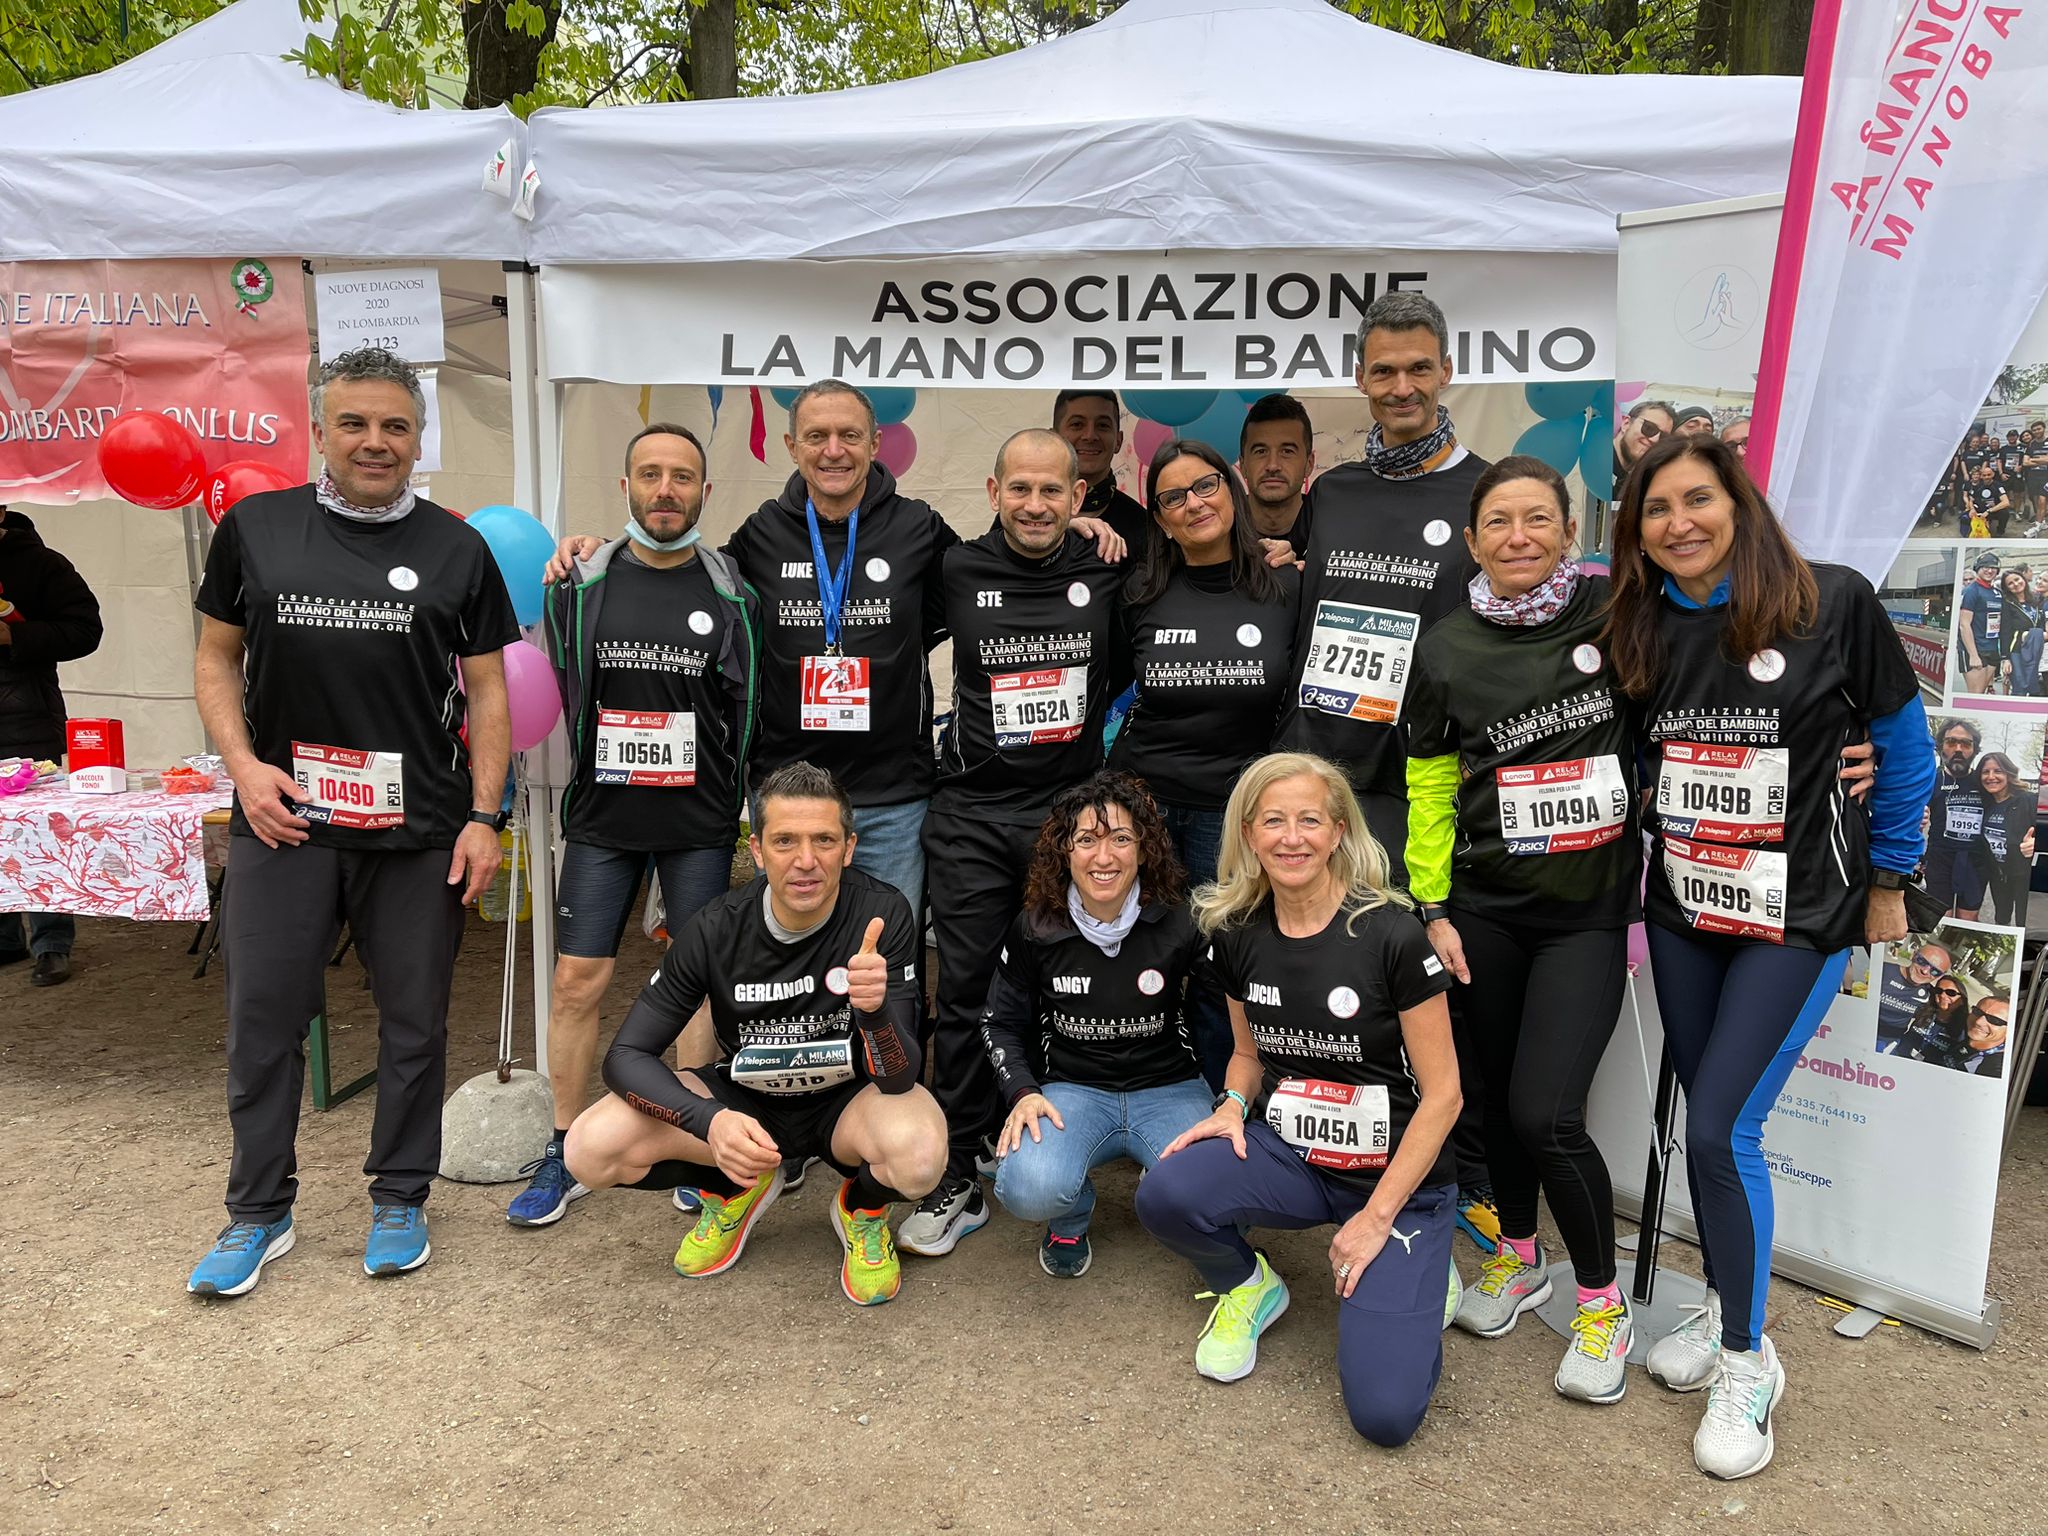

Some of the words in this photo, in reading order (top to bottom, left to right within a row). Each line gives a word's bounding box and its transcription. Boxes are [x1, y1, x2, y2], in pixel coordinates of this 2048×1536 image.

[328, 282, 367, 295] NUOVE
[370, 279, 425, 292] DIAGNOSI
[43, 291, 212, 328] ITALIANA
[365, 298, 390, 310] 2020
[338, 320, 350, 330] IN
[352, 315, 421, 329] LOMBARDIA
[720, 333, 806, 378] LA
[832, 335, 1045, 381] MANO
[1072, 335, 1207, 381] DEL
[1234, 326, 1597, 380] BAINO
[1327, 558, 1339, 567] LA
[1340, 559, 1369, 570] MANO
[1370, 562, 1389, 573] DEL
[1390, 565, 1437, 579] BAMBINO
[1330, 550, 1440, 569] ASSOCIAZIONE
[781, 562, 813, 579] LUKE
[1325, 569, 1434, 590] MANOBAMBINO.ORG
[277, 593, 415, 612] ASSOCIAZIONE
[779, 598, 891, 606] ASSOCZIONE
[977, 590, 1003, 608] STE
[277, 603, 292, 613] LA
[294, 604, 331, 617] MANO
[334, 607, 356, 618] DEL
[359, 609, 413, 623] BAMBINO
[779, 608, 789, 616] LA
[792, 608, 821, 617] MANO
[779, 616, 891, 627] MANOBAINO.ORG
[1325, 612, 1355, 624] Telepass
[1379, 619, 1413, 631] MILANO
[277, 615, 411, 634] MANOBAMBINO.ORG
[979, 632, 1092, 646] ASSOCIAZIONE
[1154, 629, 1197, 645] BETTA
[1347, 635, 1370, 645] FABRIZIO
[595, 641, 710, 659] ASSOCIAZIONE
[980, 647, 993, 656] LA
[995, 644, 1025, 655] MANO
[1027, 643, 1046, 652] DEL
[1048, 640, 1092, 652] BAMBINO
[597, 651, 607, 659] LA
[608, 650, 638, 659] MANO
[640, 651, 659, 661] DEL
[661, 653, 706, 668] BAMBINO
[981, 650, 1092, 665] MANOBAMBINO.ORG
[1146, 660, 1264, 669] ASSOCIAZIONE
[1323, 643, 1385, 681] 2735
[1145, 677, 1266, 687] MANOBAMBINO.ORG
[1146, 669, 1156, 678] LA
[1158, 669, 1189, 678] MANO
[1192, 669, 1213, 678] DEL
[1216, 668, 1264, 677] BAMBINO
[1016, 699, 1070, 725] 1052A
[1486, 687, 1611, 734] ASSOCIAZIONE
[1490, 732, 1507, 744] LA
[1506, 719, 1538, 737] MANO
[1540, 713, 1562, 727] DEL
[1563, 698, 1613, 719] BAMBINO
[1696, 719, 1718, 730] DEL
[1720, 719, 1780, 731] BAMBINO
[1496, 710, 1615, 753] MANOBAMBINO.ORG
[617, 741, 673, 765] 1056A
[1711, 750, 1738, 759] RELAY
[1504, 773, 1532, 781] Lenovo
[1555, 765, 1579, 773] RELAY
[318, 777, 374, 808] 1049D
[1681, 782, 1752, 815] 1049B
[1529, 796, 1600, 828] 1049A
[1951, 820, 1979, 830] 1919C
[1711, 851, 1739, 860] RELAY
[1682, 876, 1752, 913] 1049C
[734, 975, 815, 1002] GERLANDO
[1053, 976, 1091, 994] ANGY
[739, 1026, 753, 1034] LA
[754, 1025, 786, 1035] MANO
[788, 1024, 807, 1034] DEL
[1065, 1023, 1095, 1034] MANO
[1097, 1027, 1117, 1035] DEL
[1119, 1020, 1164, 1034] BAMBINO
[1258, 1034, 1285, 1046] MANO
[1287, 1037, 1307, 1048] DEL
[1309, 1040, 1361, 1054] BAMBINO
[744, 1056, 781, 1066] Telepass
[809, 1050, 845, 1060] MILANO
[1323, 1087, 1347, 1095] RELAY
[1796, 1097, 1867, 1124] 335.7644193
[1294, 1113, 1359, 1146] 1045A
[1780, 1164, 1832, 1188] Giuseppe
